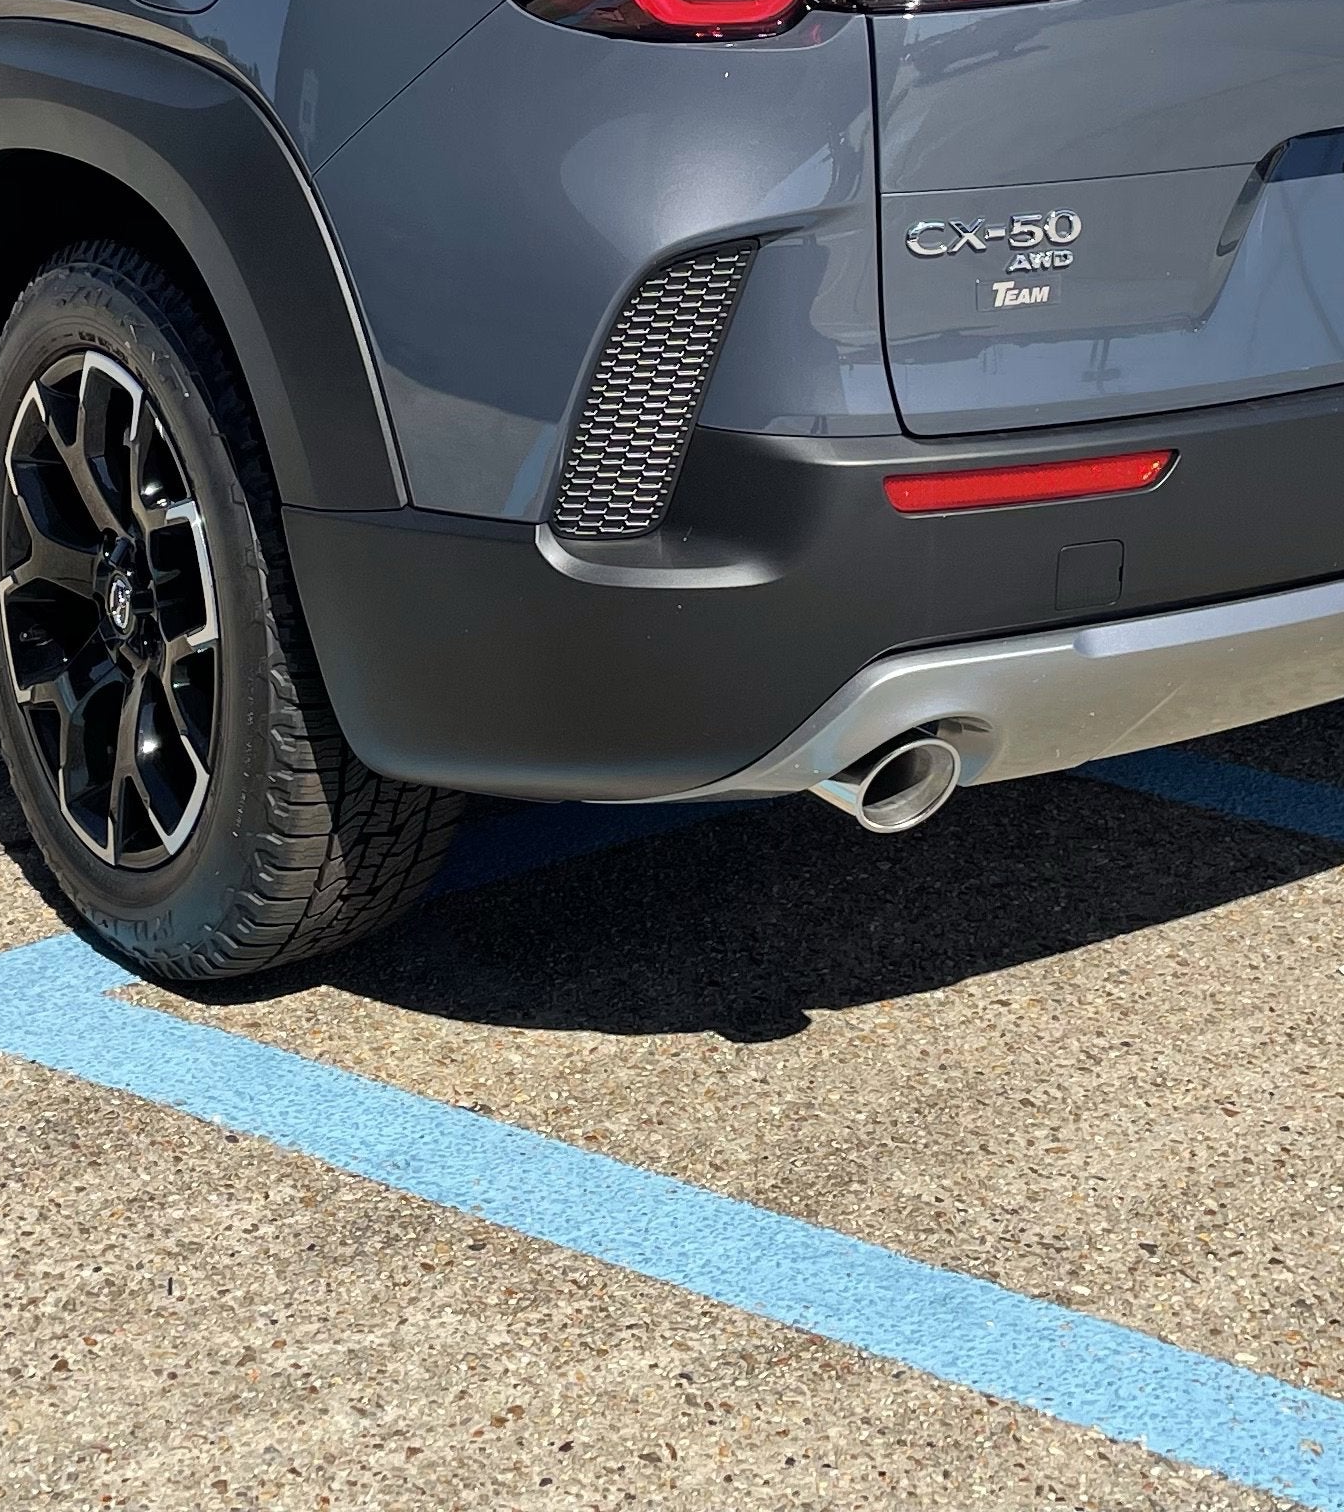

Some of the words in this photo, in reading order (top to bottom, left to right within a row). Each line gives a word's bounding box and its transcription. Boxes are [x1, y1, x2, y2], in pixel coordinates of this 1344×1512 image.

[906, 208, 1082, 258] CX-50
[1007, 249, 1074, 274] AWD
[992, 281, 1050, 308] TEAM
